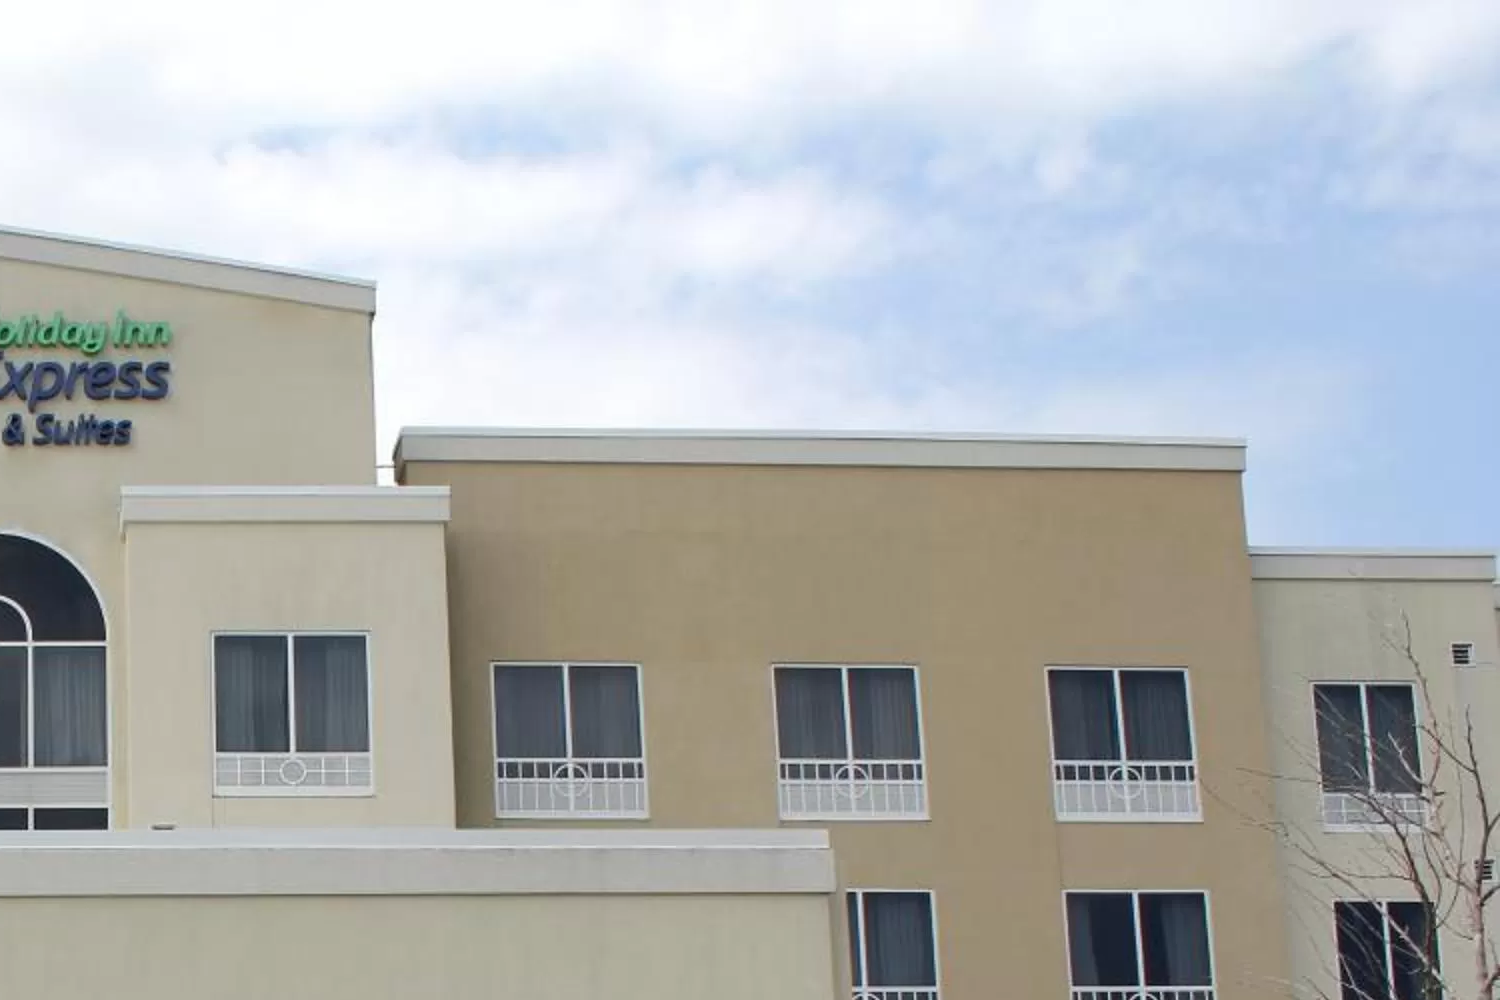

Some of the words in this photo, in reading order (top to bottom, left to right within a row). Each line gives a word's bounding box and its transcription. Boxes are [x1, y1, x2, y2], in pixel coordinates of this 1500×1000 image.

[113, 309, 172, 348] Inn
[2, 413, 25, 446] &
[32, 412, 132, 446] Suites
